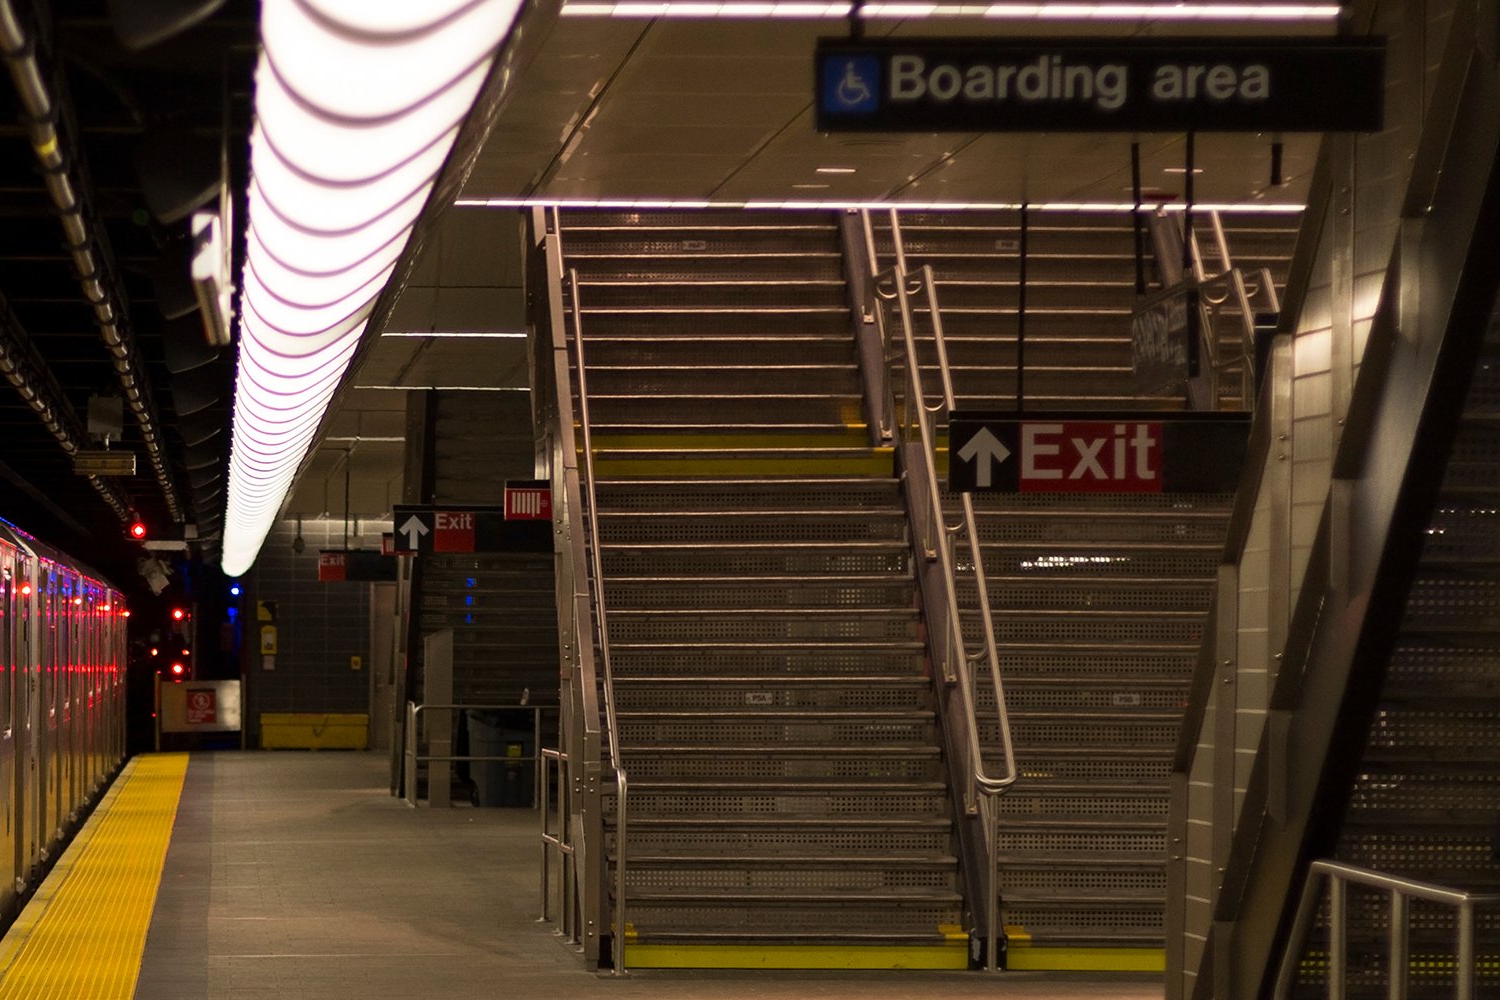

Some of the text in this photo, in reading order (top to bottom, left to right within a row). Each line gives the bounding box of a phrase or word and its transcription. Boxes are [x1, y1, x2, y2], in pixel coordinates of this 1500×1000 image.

[888, 54, 1271, 110] Boarding area
[1020, 423, 1156, 480] Exit
[434, 512, 473, 530] Exit
[320, 555, 346, 566] Exit
